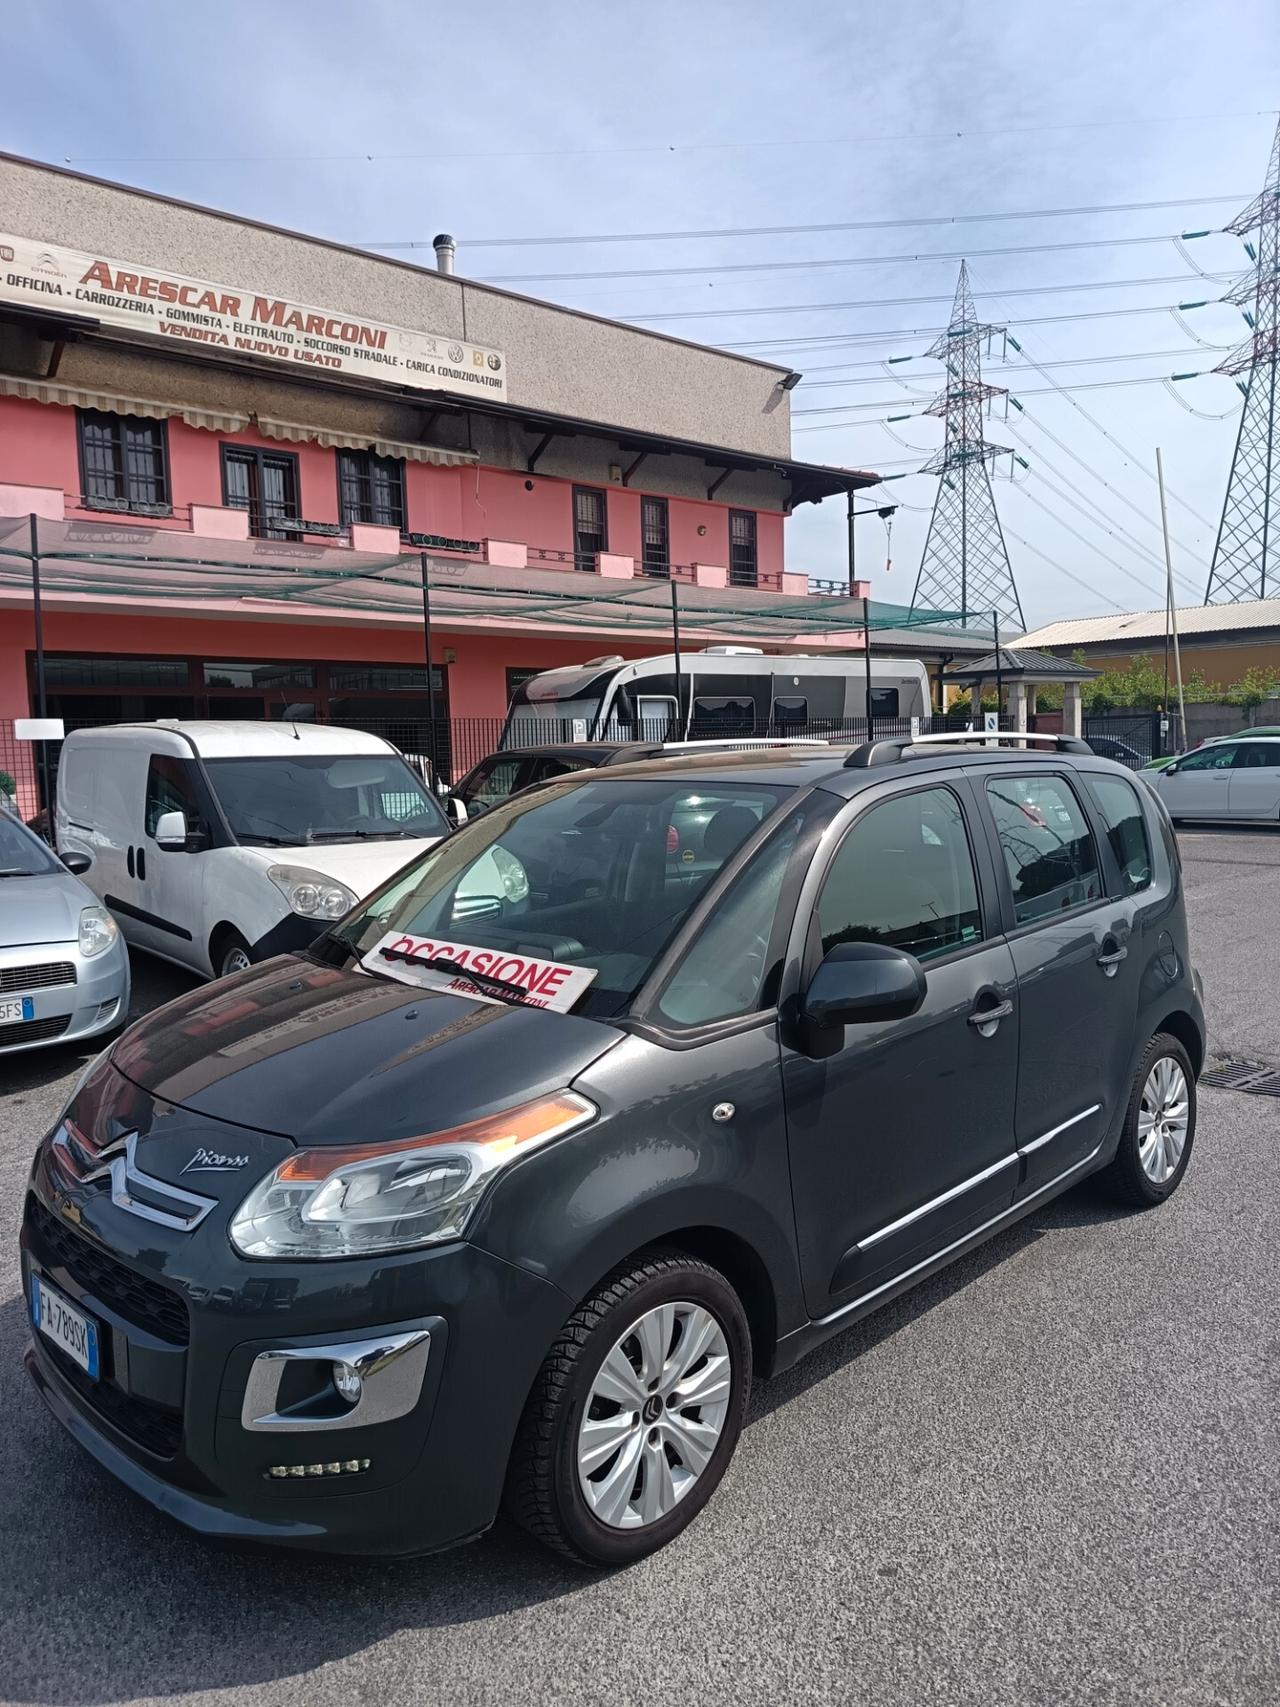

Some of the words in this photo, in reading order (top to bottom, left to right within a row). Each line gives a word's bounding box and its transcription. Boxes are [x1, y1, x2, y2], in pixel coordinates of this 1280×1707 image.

[7, 273, 63, 296] OFFICINA
[75, 288, 154, 316] CARROZZERIA
[166, 308, 222, 329] GOMMISTA
[233, 321, 294, 344] ELETTRAUTO
[304, 337, 351, 357] SOCCORSO
[353, 347, 398, 367] STRADALE
[406, 359, 436, 375] CARICA
[437, 366, 503, 389] CONDIZIONATORI
[79, 260, 241, 317] ARESCAR
[250, 295, 388, 350] MARCONI
[159, 320, 229, 346] VENDITA
[234, 336, 290, 358] NUOVO
[293, 347, 342, 369] USATO
[384, 937, 573, 996] OCCASIONE
[179, 1148, 249, 1176] Picasso
